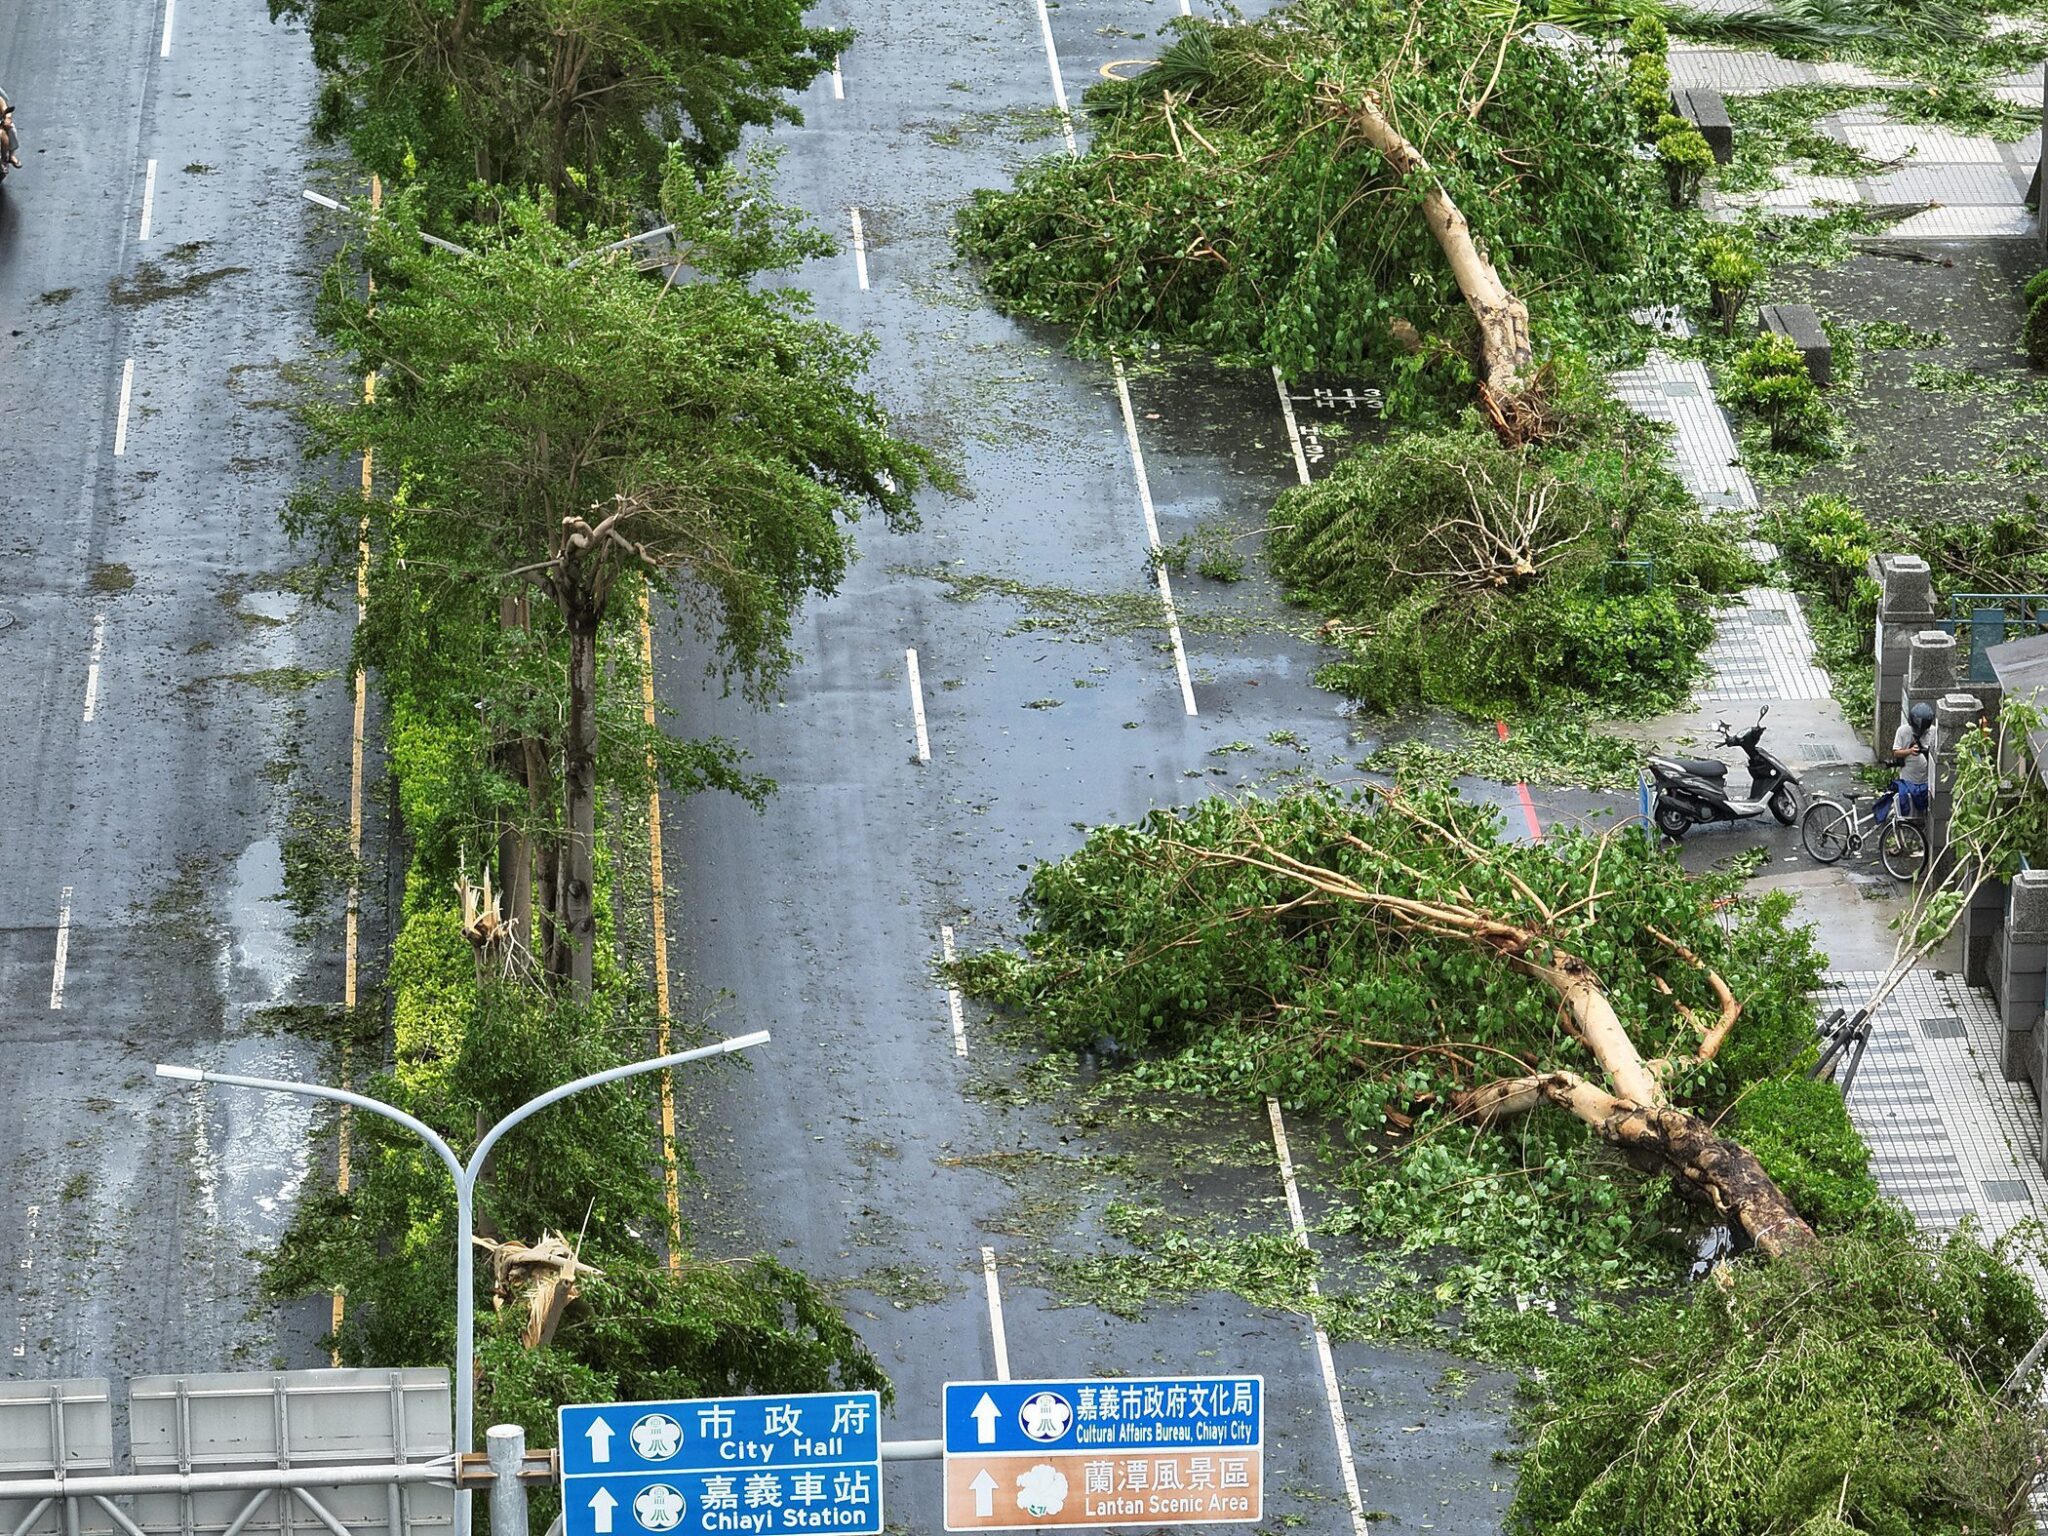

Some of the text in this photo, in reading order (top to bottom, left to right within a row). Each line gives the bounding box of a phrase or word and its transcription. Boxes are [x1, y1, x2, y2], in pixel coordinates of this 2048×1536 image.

[1076, 1382, 1253, 1421] 嘉義市政府文化局
[697, 1400, 870, 1439] 市政府
[1076, 1419, 1252, 1445] Cultural Affairs Bureau, Chiayi City
[719, 1437, 843, 1463] City Hall
[700, 1470, 871, 1510] 嘉義車站
[1084, 1456, 1249, 1495] 蘭潭風景區
[701, 1506, 867, 1533] Chiayi Station
[1085, 1493, 1248, 1517] Lantan Scenic Area
